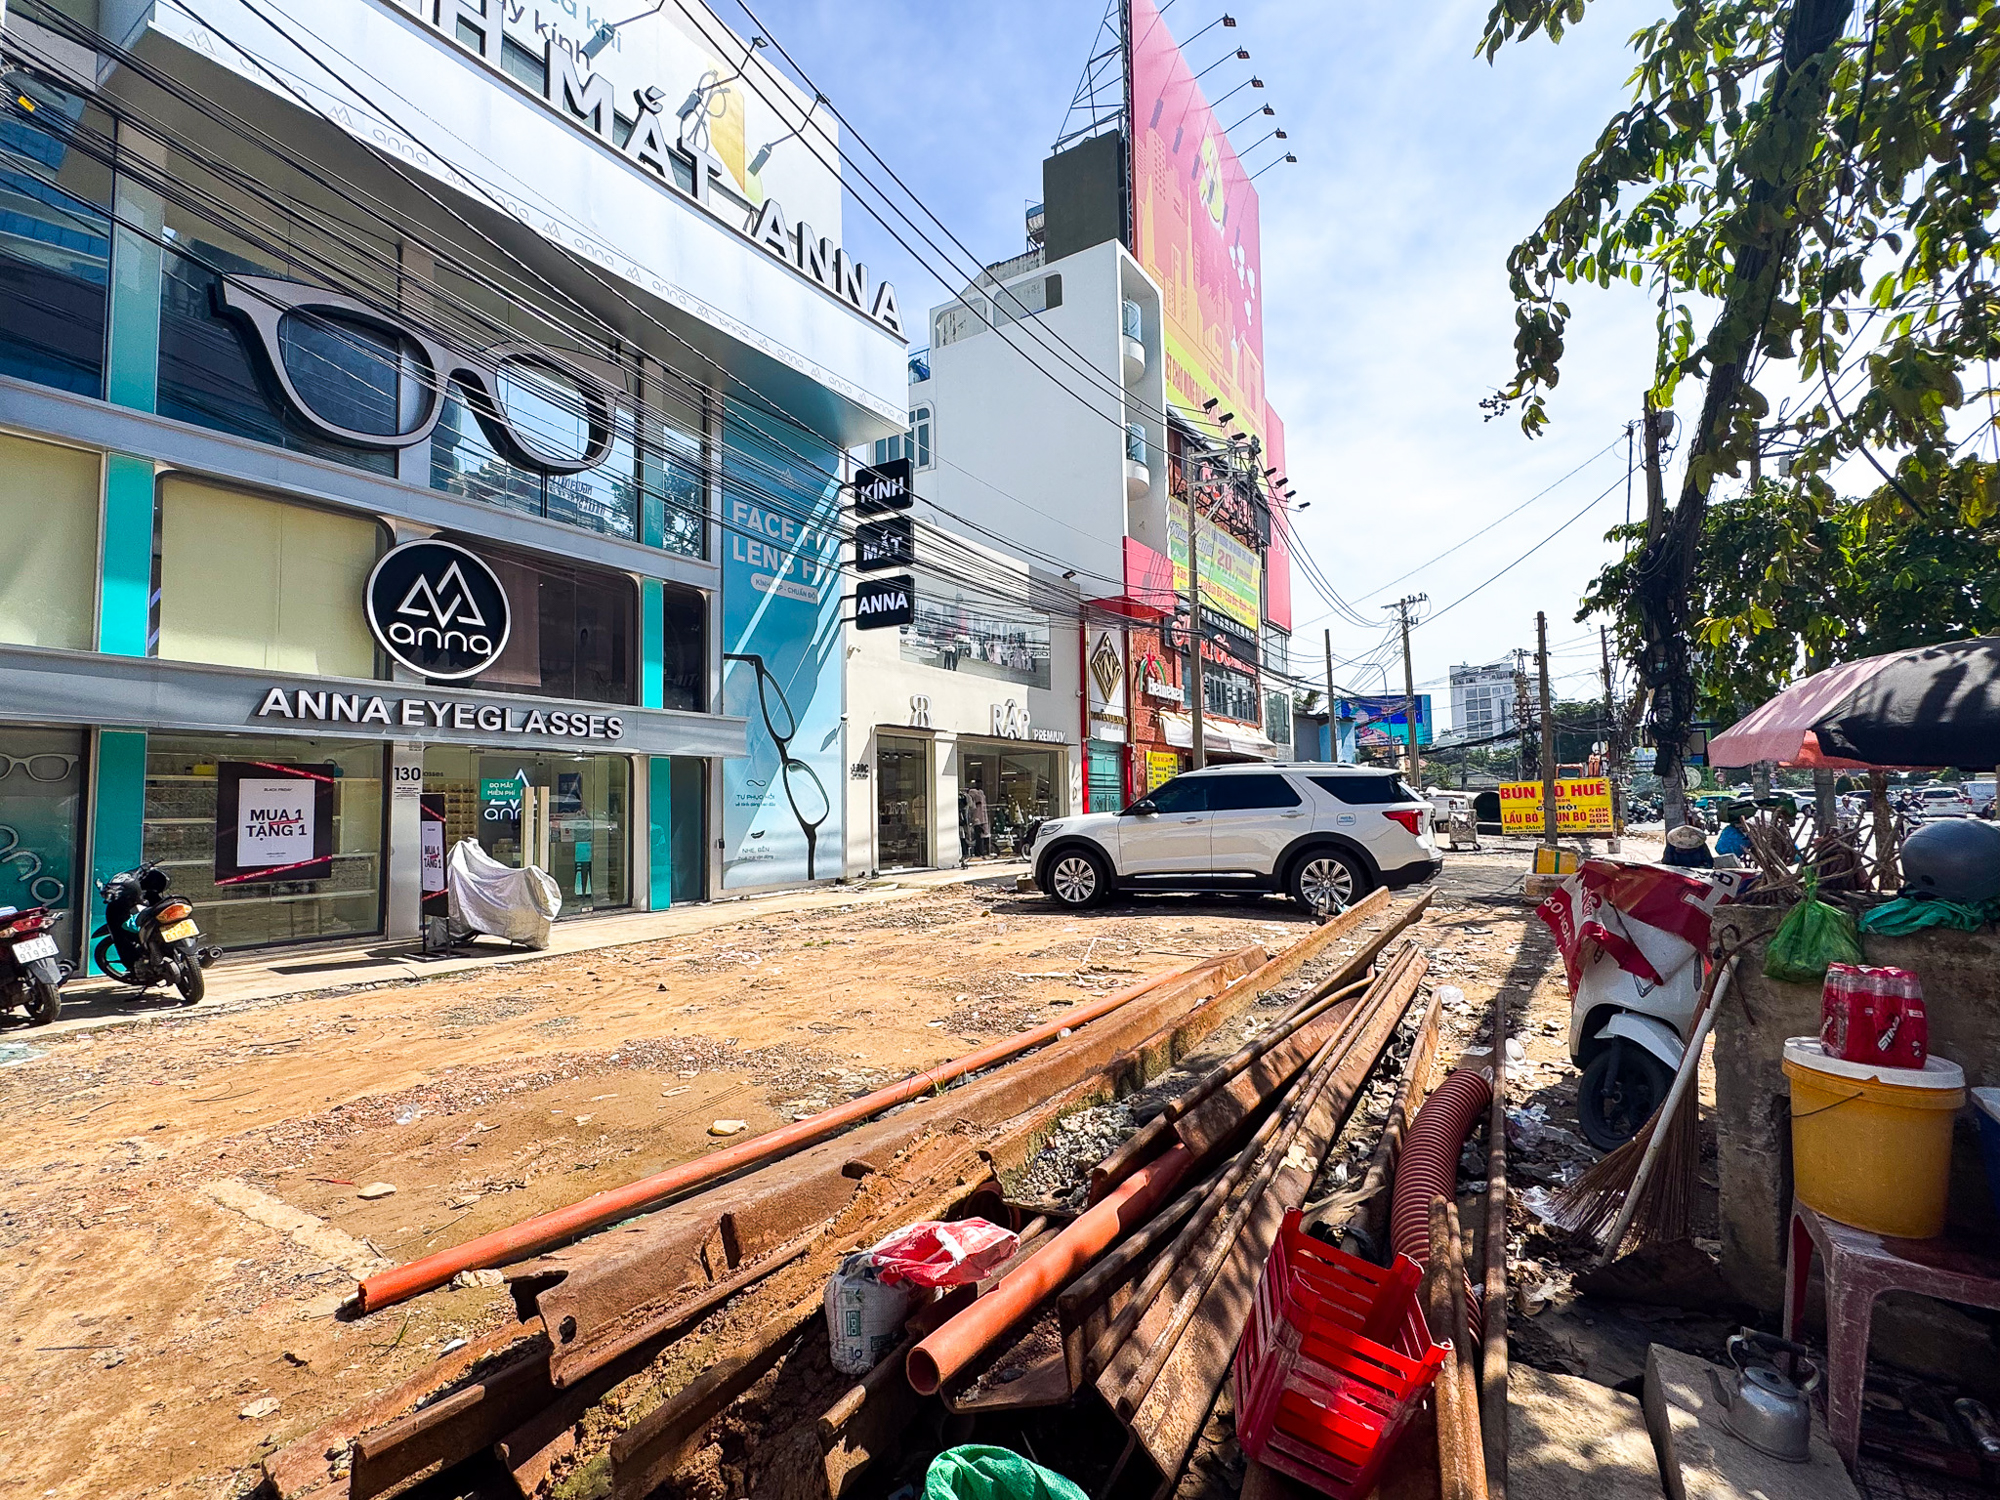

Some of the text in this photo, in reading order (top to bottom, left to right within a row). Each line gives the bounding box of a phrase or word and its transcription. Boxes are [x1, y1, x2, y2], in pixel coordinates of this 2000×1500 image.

[372, 128, 430, 167] anna
[545, 38, 723, 207] MẮT
[751, 198, 907, 338] ANNA
[573, 237, 615, 267] anna
[652, 279, 688, 306] anna
[777, 348, 804, 369] anna
[828, 375, 853, 394] anna
[873, 401, 896, 418] anna
[861, 477, 904, 504] KÍNH
[732, 501, 796, 543] FACE
[732, 536, 795, 575] LENS
[858, 593, 909, 616] ANNA
[388, 622, 493, 656] anna
[1147, 676, 1185, 702] Heineken
[258, 687, 625, 740] ANNA EYEGLASSES
[990, 699, 1031, 740] RẬP
[394, 767, 421, 781] 130
[1500, 784, 1536, 799] BÚN
[1571, 779, 1606, 797] HUẾ
[250, 809, 304, 821] MUA 1
[484, 807, 523, 820] ann
[1525, 810, 1538, 823] BÒ
[246, 822, 307, 841] TẶNG 1
[424, 845, 436, 855] MUA
[423, 856, 438, 871] TẶNG
